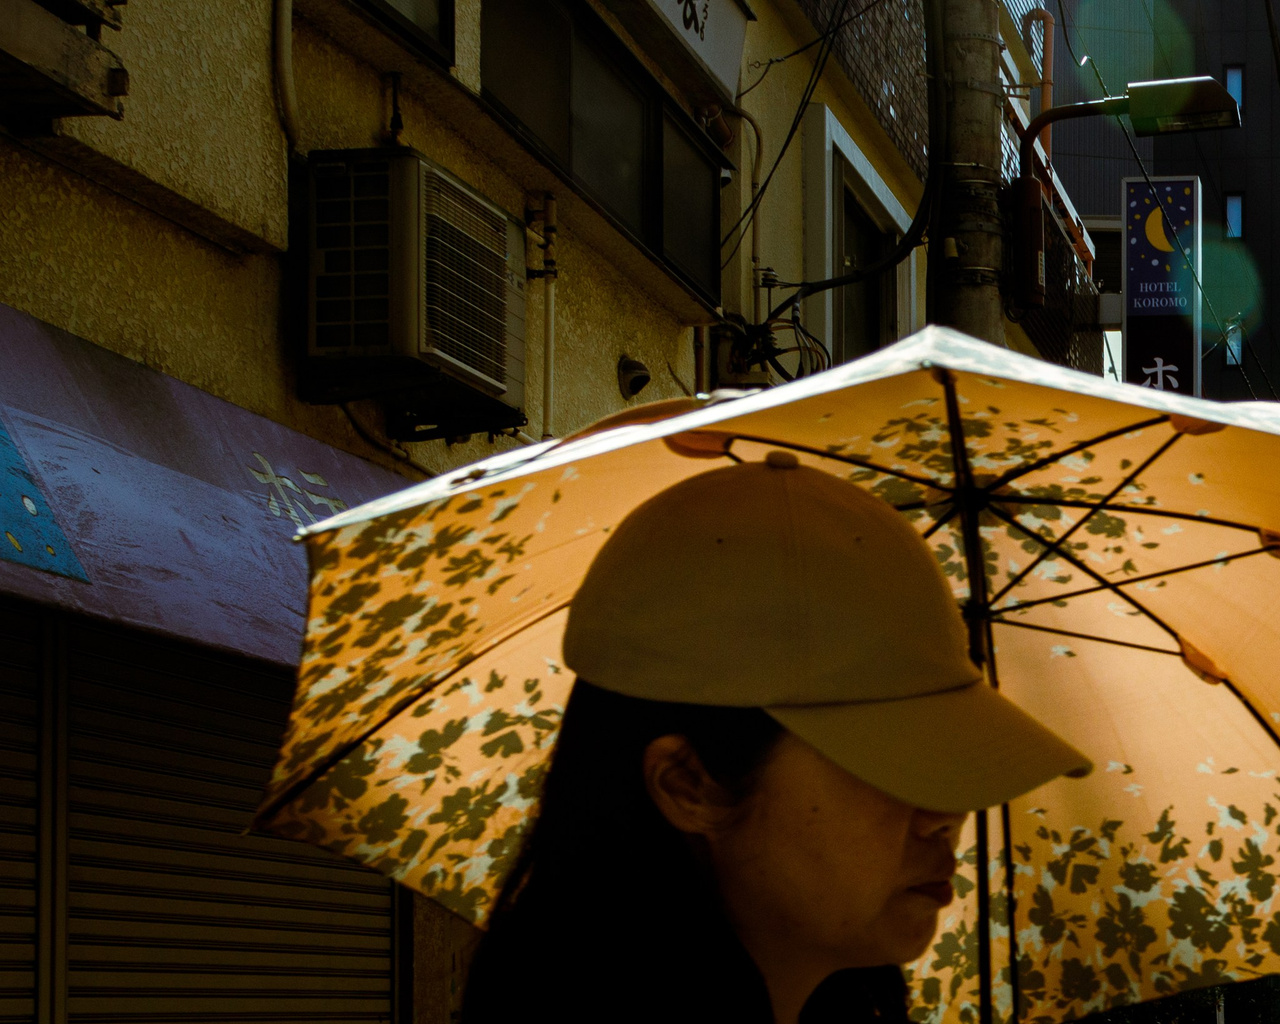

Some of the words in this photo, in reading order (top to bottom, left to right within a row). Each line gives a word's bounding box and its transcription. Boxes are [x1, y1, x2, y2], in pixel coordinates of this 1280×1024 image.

[1139, 282, 1182, 294] HOTEL
[1133, 297, 1188, 309] KOROMO
[1141, 356, 1180, 391] ホ
